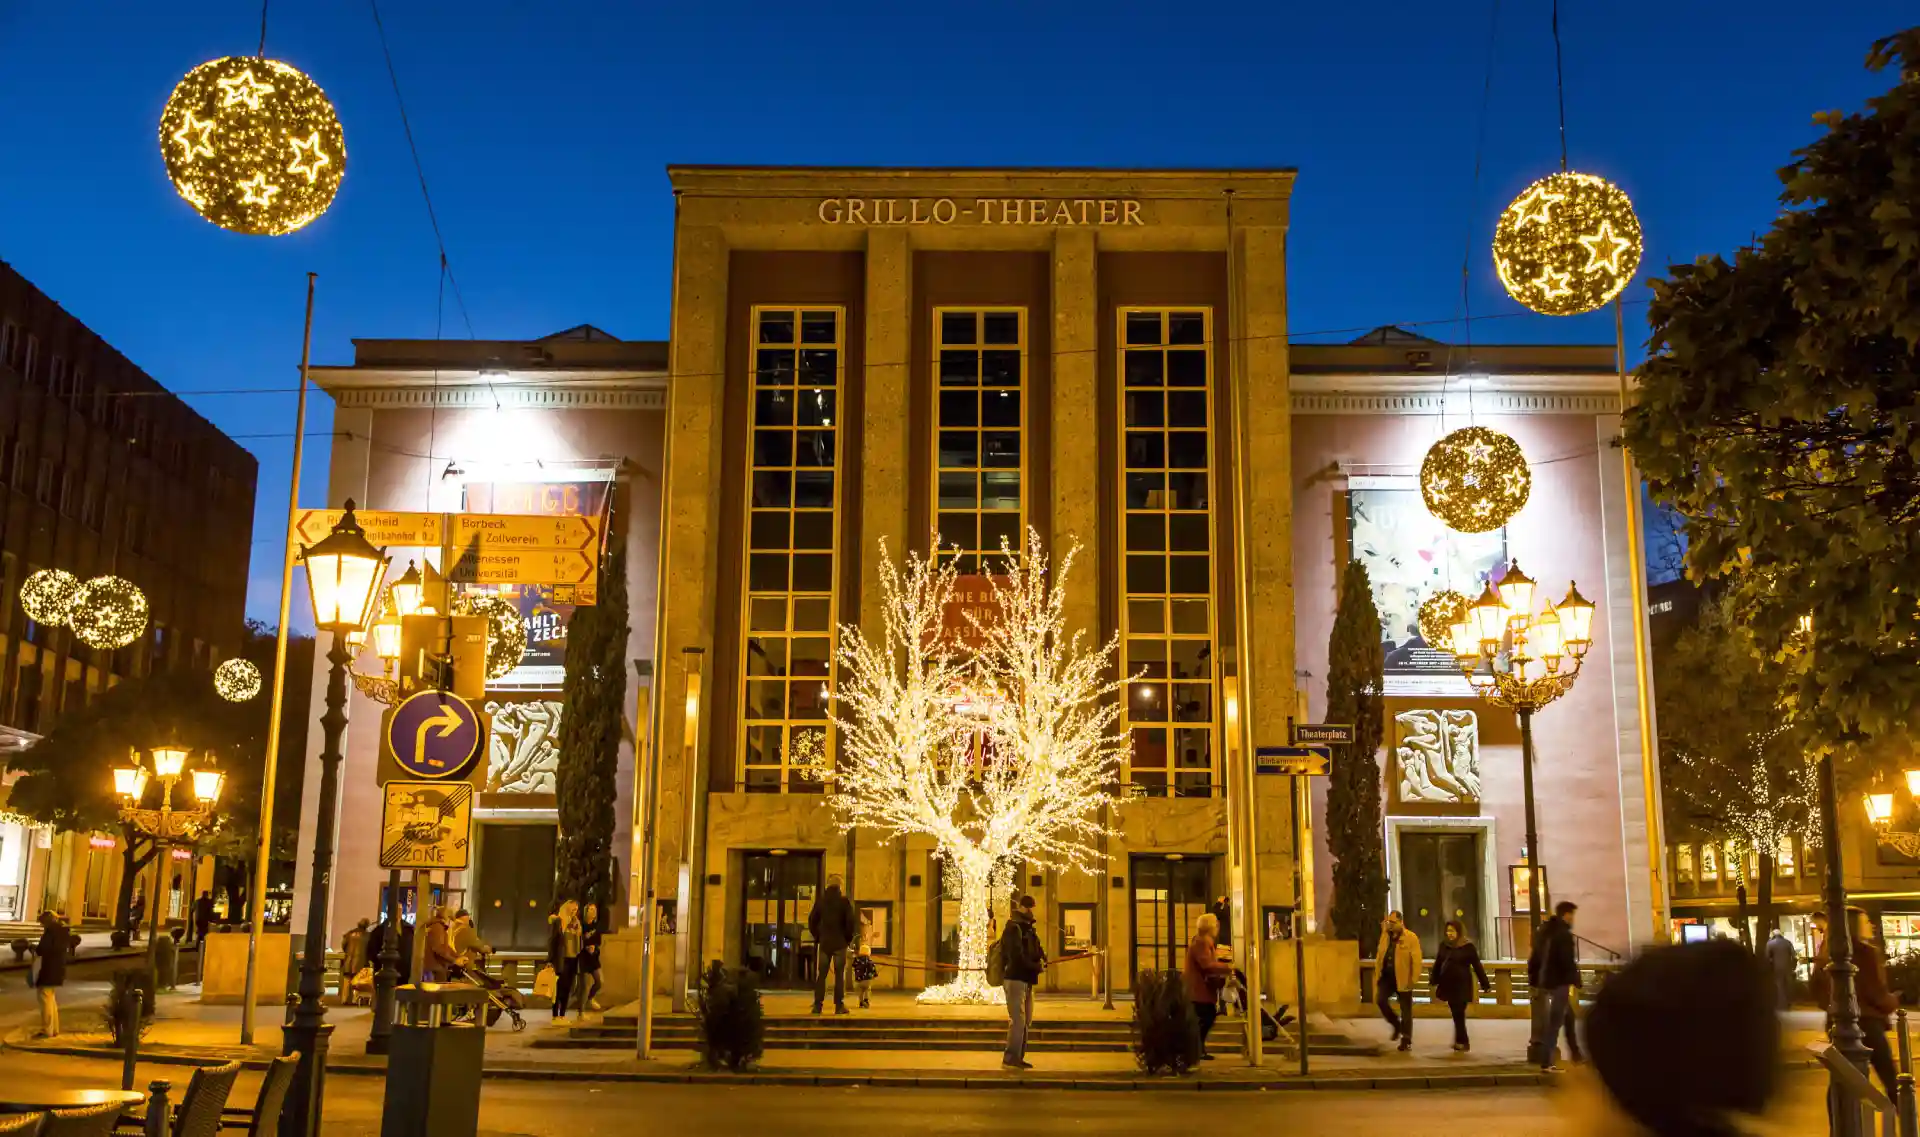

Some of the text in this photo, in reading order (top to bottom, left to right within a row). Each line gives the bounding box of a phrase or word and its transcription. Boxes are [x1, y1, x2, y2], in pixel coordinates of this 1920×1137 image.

[818, 198, 1145, 225] GRILLO-THEATER
[462, 519, 506, 529] Borbeck
[366, 531, 416, 541] uptbahnhof
[486, 533, 539, 545] Zollverein
[460, 553, 520, 565] Altenessen
[460, 567, 518, 579] Universität
[523, 613, 559, 630] AHLT
[532, 625, 569, 642] ZECH
[1300, 729, 1348, 740] Theaterplatz
[403, 847, 447, 863] ZONE
[321, 872, 329, 884] 2
